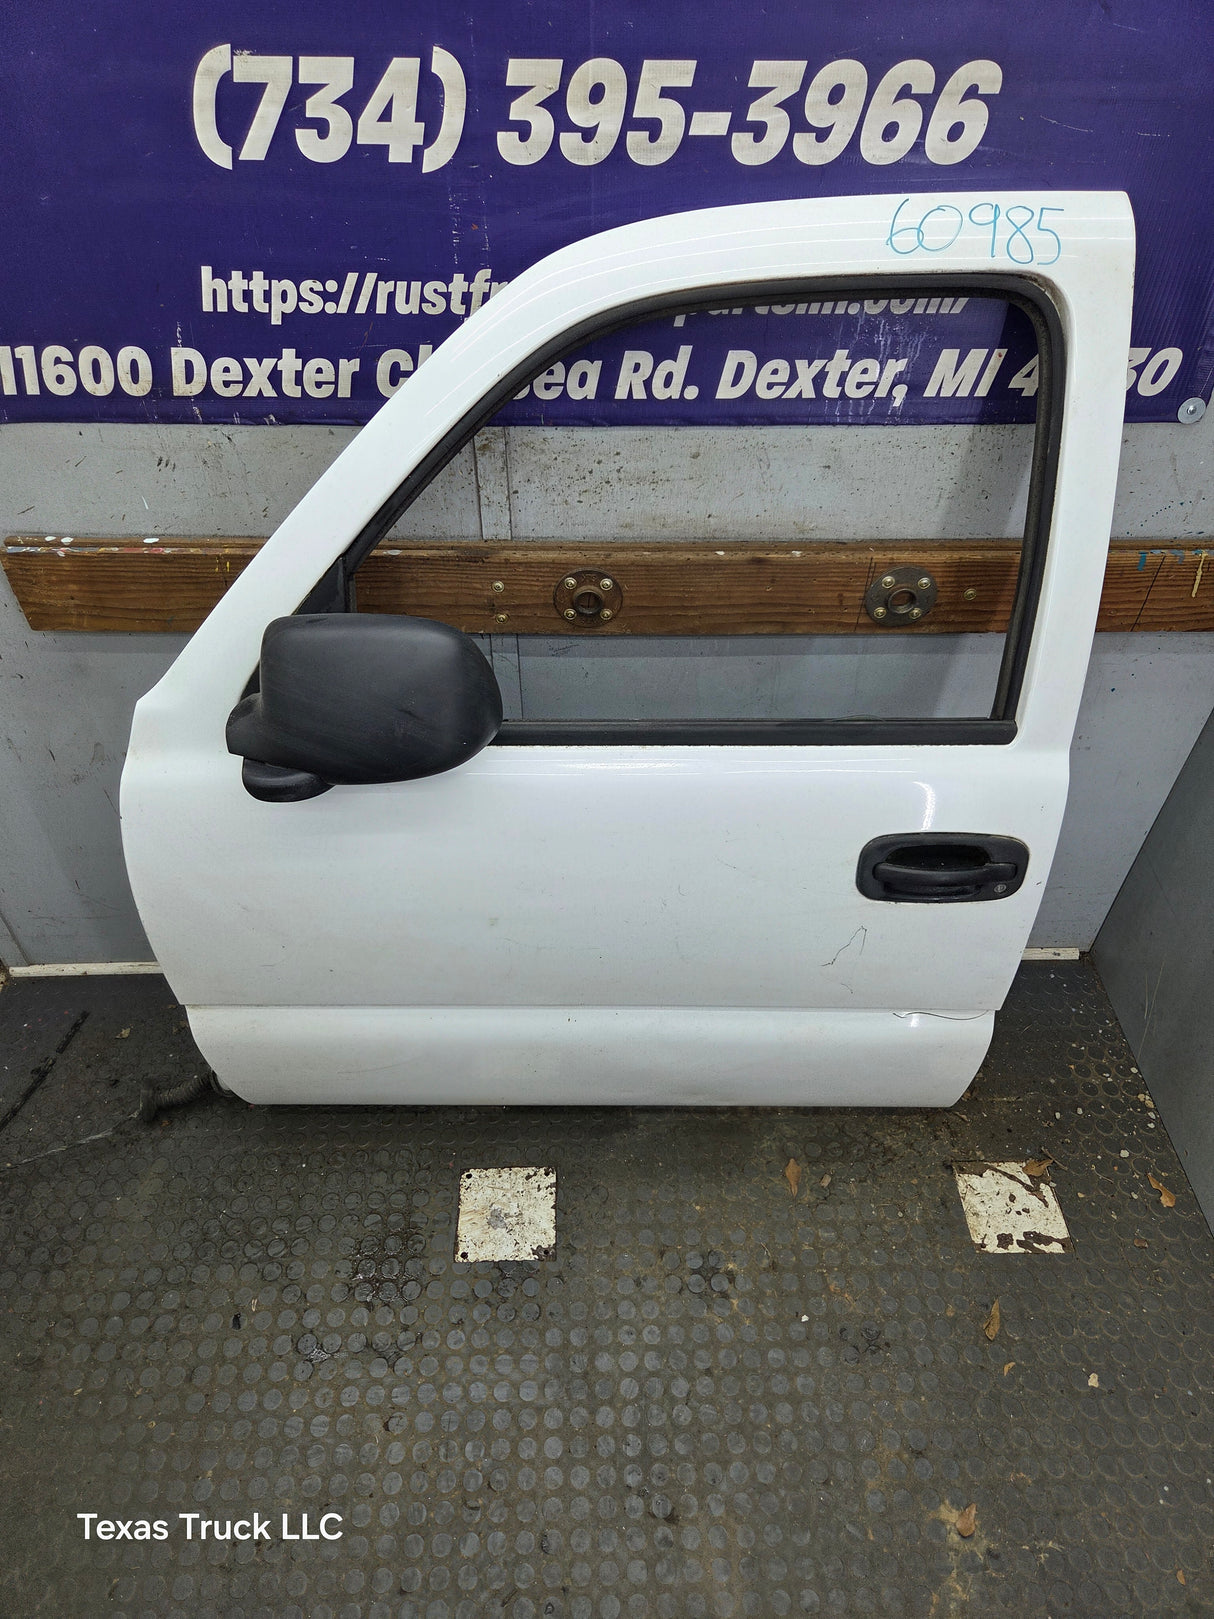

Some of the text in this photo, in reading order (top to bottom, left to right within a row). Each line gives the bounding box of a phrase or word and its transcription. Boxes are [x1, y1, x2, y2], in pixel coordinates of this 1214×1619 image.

[193, 43, 1002, 173] (734) 395-3966
[886, 197, 1065, 266] 60985
[0, 344, 153, 397] 11600
[171, 346, 360, 398] Dexter
[614, 345, 700, 400] Rd.
[715, 349, 909, 407] Dexter,
[923, 348, 1008, 397] MI
